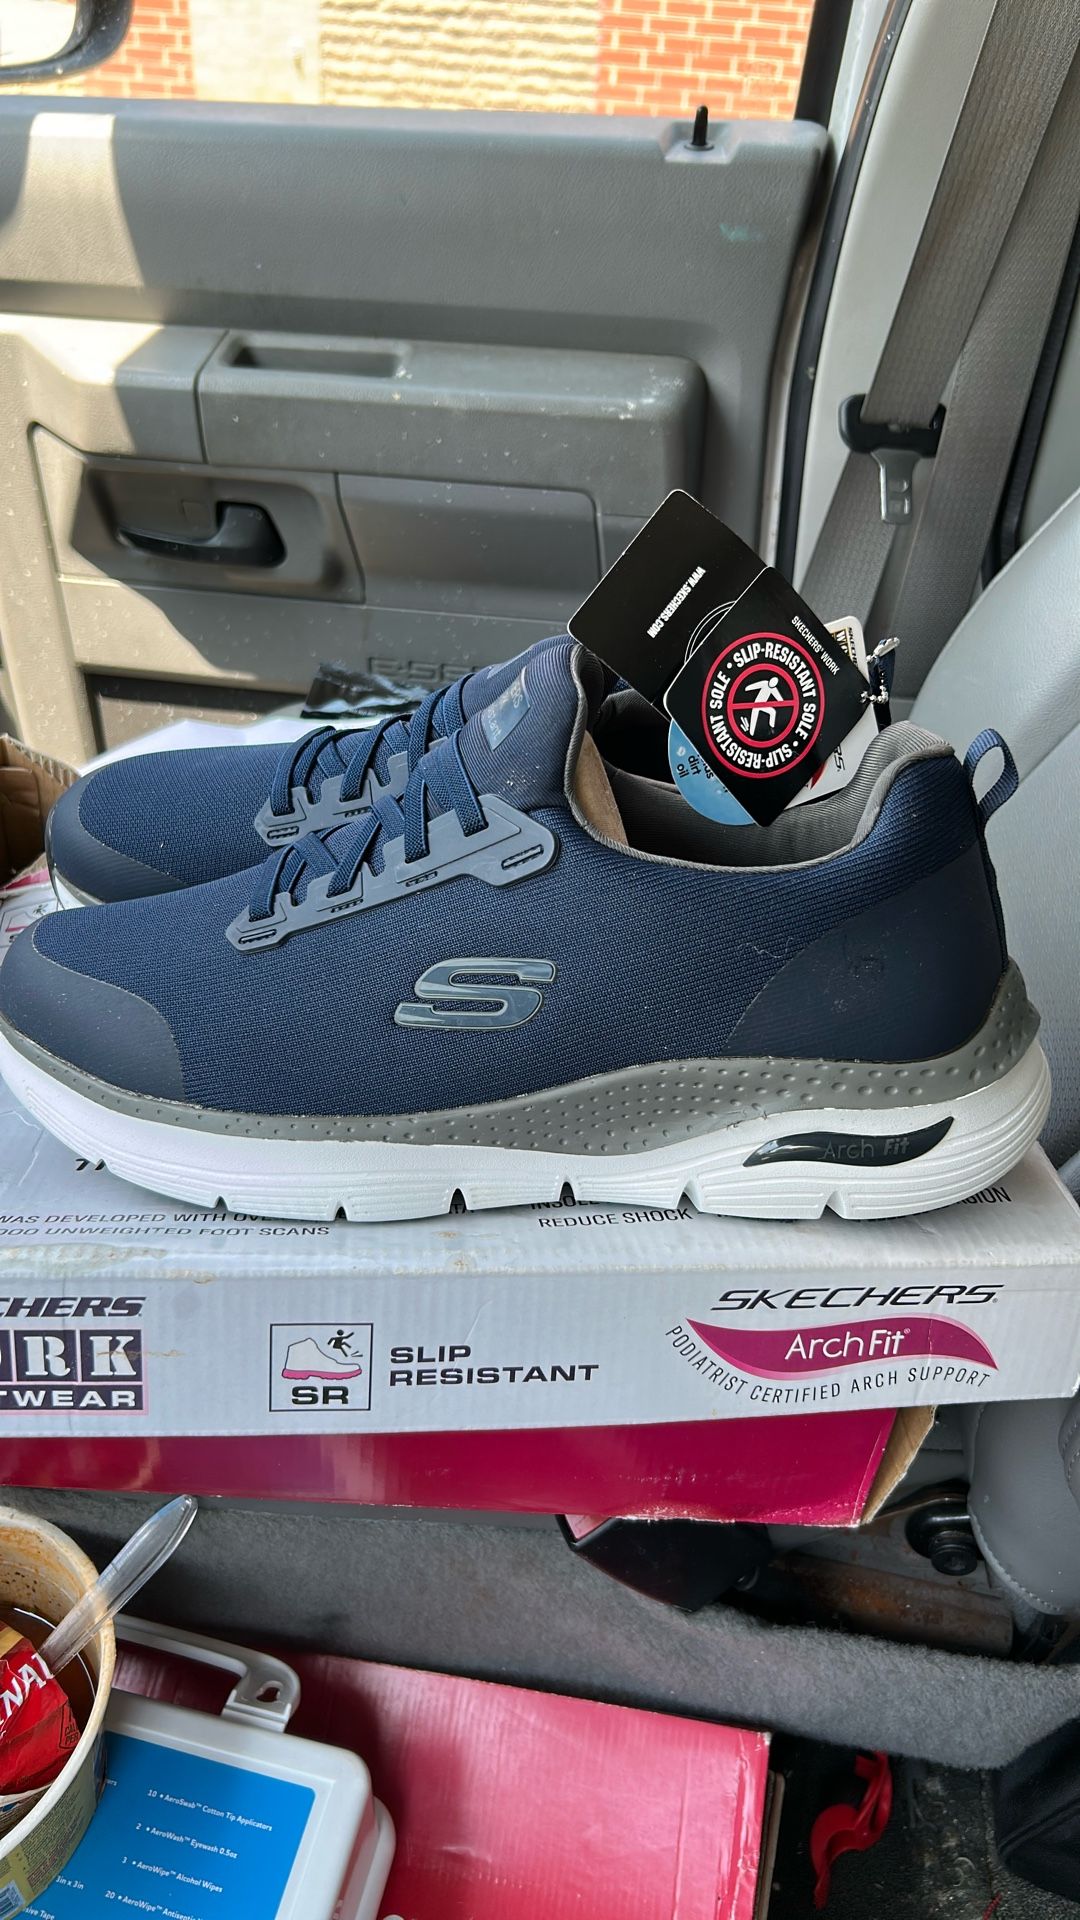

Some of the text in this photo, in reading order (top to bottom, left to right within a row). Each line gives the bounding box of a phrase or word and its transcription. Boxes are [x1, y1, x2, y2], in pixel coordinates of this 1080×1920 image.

[646, 566, 706, 639] WWW.SKECHERS.COM
[820, 651, 840, 676] WORK
[733, 641, 816, 740] SLIP-RESISTANT SOLE
[709, 671, 793, 769] SLIP-RESISTANT SOLE
[676, 763, 690, 778] oil
[688, 755, 701, 776] dirt
[821, 1137, 910, 1160] Arch Fit
[45, 1214, 166, 1223] DEVELOPED
[173, 1213, 225, 1222] WITH
[538, 1208, 693, 1228] REDUCE SHOCK
[45, 1227, 192, 1236] UNWEIGHTED
[199, 1227, 254, 1236] FOOT
[259, 1226, 330, 1236] SCANS
[711, 1284, 1005, 1310] SKECHERS
[0, 1335, 137, 1377] RK
[390, 1346, 471, 1365] SLIP
[665, 1325, 990, 1403] PODIATRIST CERTIFIED ARCH SUPPORT
[390, 1364, 599, 1386] RESISTANT
[292, 1386, 349, 1406] SR
[147, 1789, 158, 1798] 10
[202, 1805, 225, 1818] Cotton
[225, 1811, 236, 1822] Tip
[236, 1815, 273, 1832] Applicators
[135, 1823, 142, 1831] 2
[190, 1839, 219, 1854] Eyewash
[73, 1880, 84, 1889] 3in
[122, 1857, 128, 1865] 3
[176, 1873, 201, 1886] Alcohol
[202, 1880, 223, 1893] Wipes
[105, 1890, 116, 1900] 20
[40, 1910, 55, 1920] Tape
